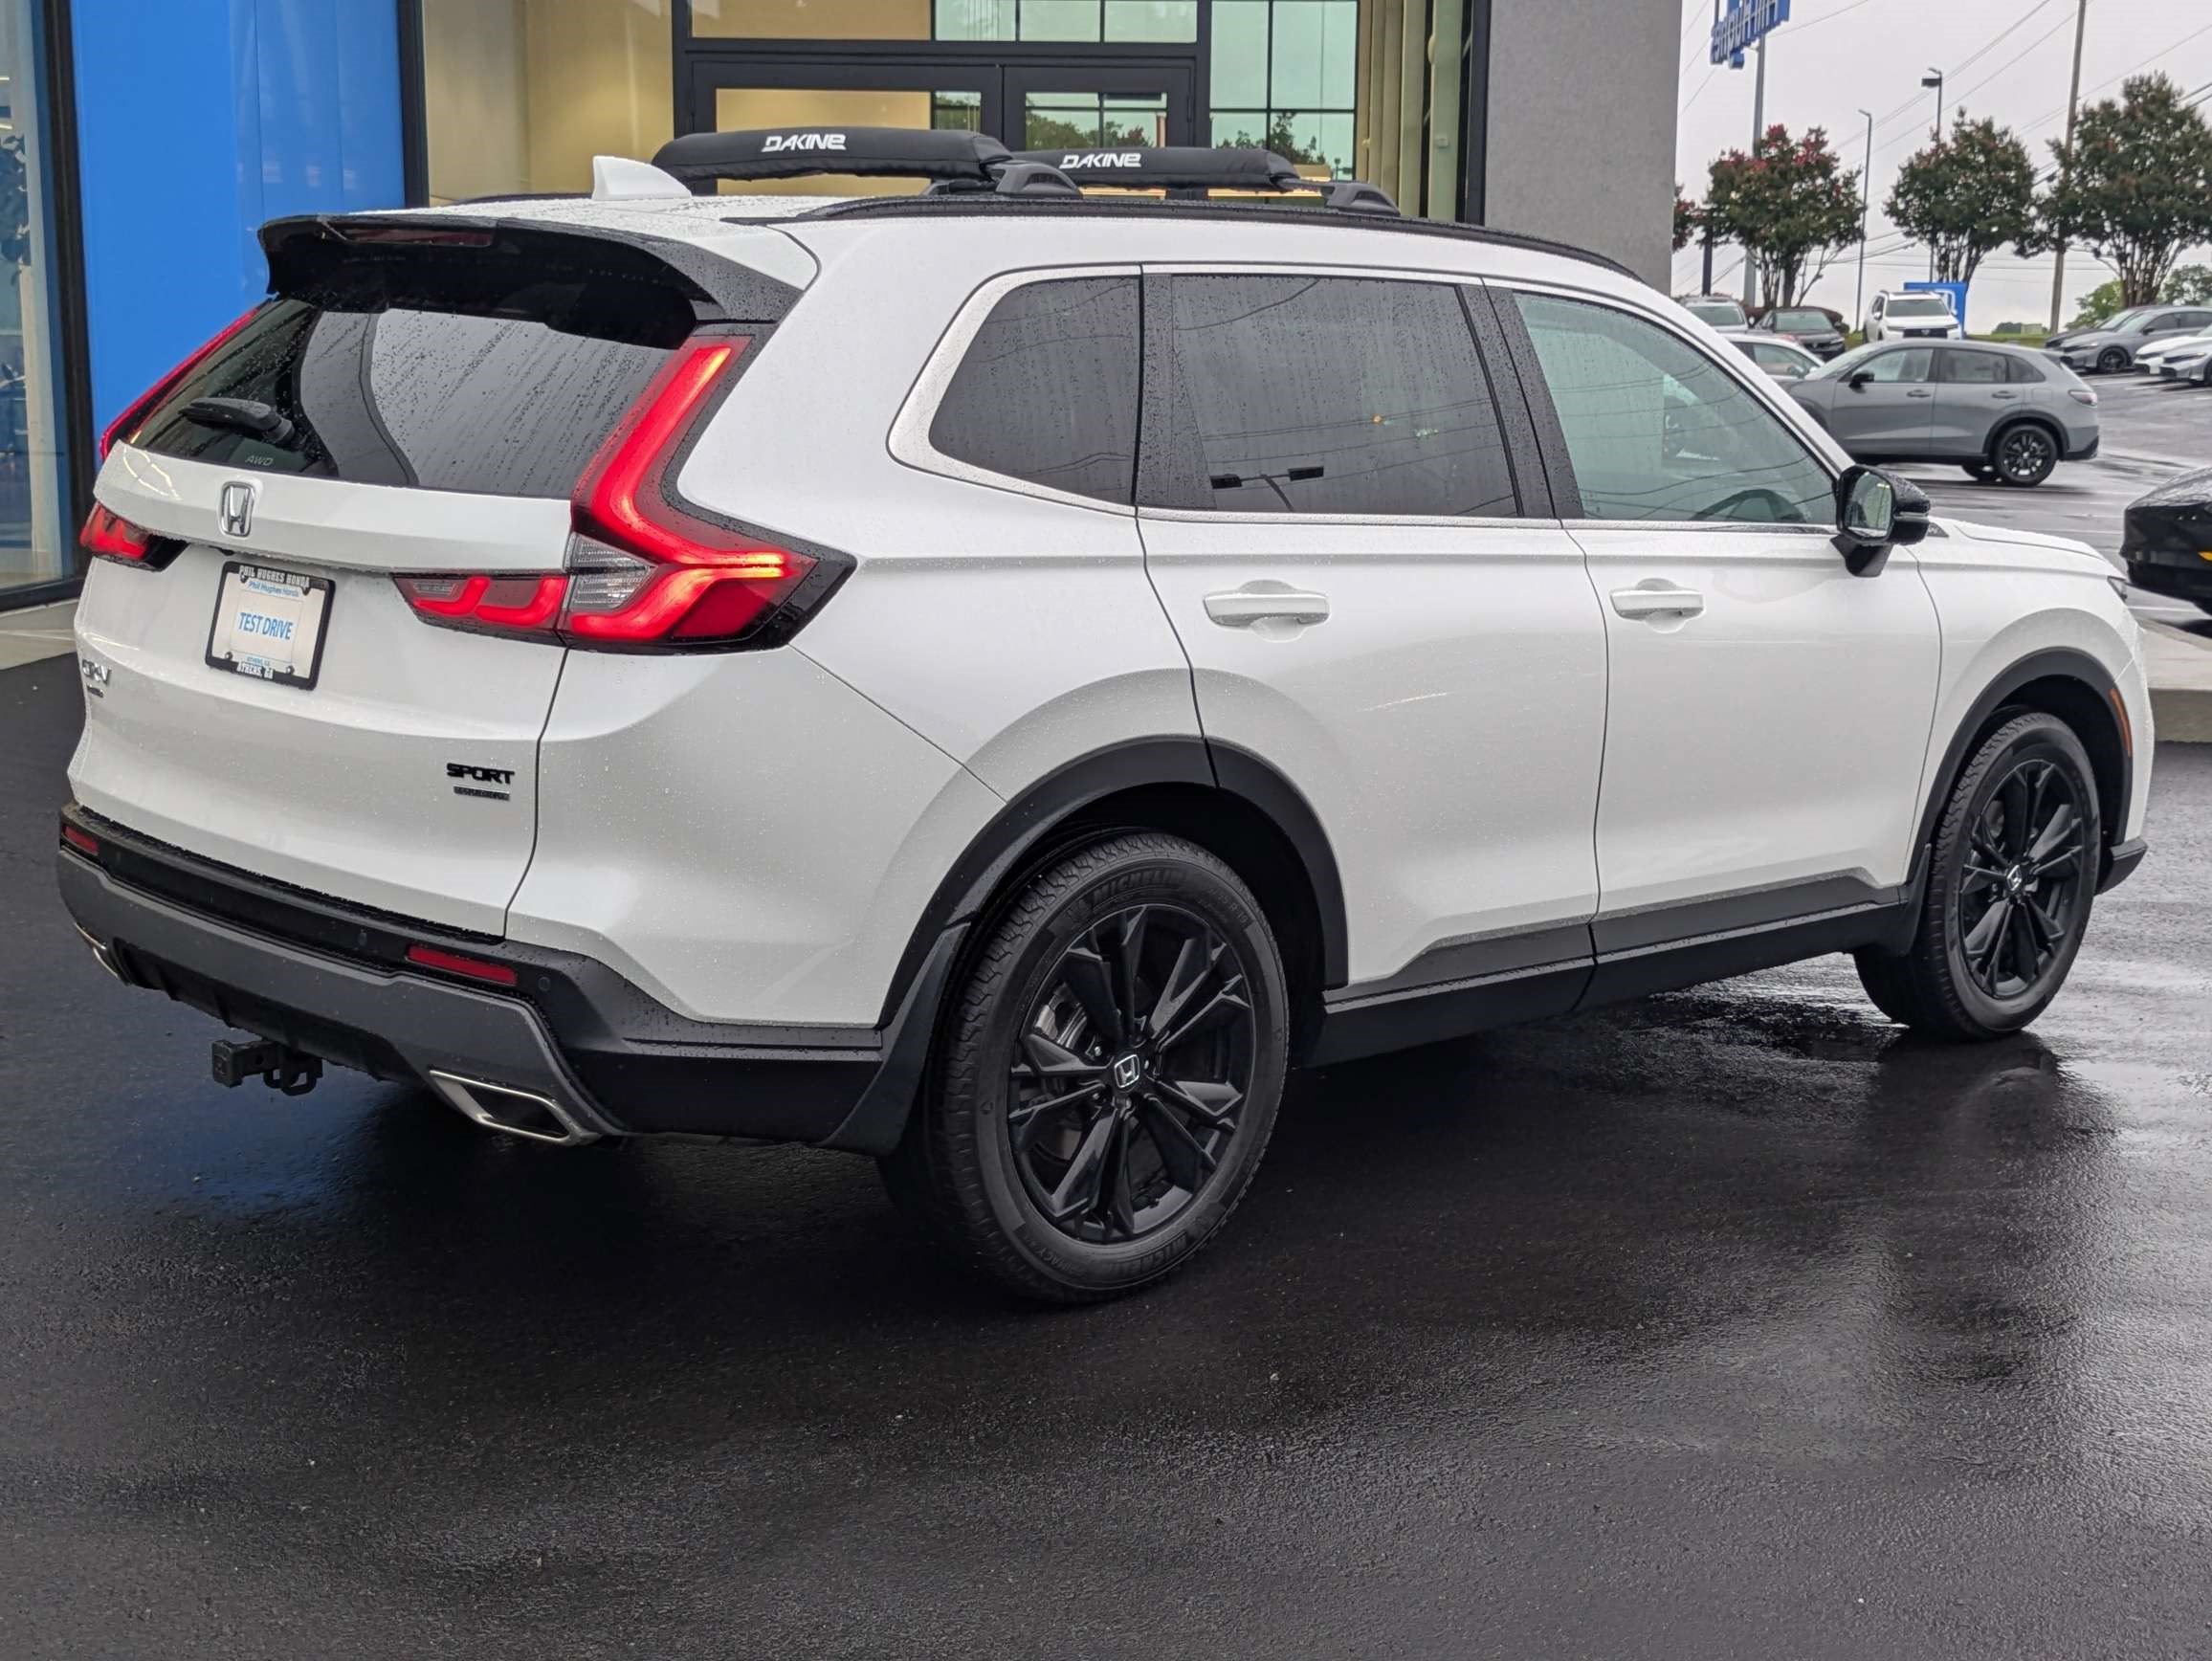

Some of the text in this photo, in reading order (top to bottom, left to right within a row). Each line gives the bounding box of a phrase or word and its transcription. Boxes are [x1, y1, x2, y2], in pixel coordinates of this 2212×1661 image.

[761, 132, 847, 153] DAKINE
[1059, 151, 1142, 169] DAKINE
[245, 454, 274, 466] AWD
[238, 565, 311, 589] PHIL HUGHES HONDA
[239, 611, 294, 640] TEST DRIVE
[446, 762, 516, 785] SPORT
